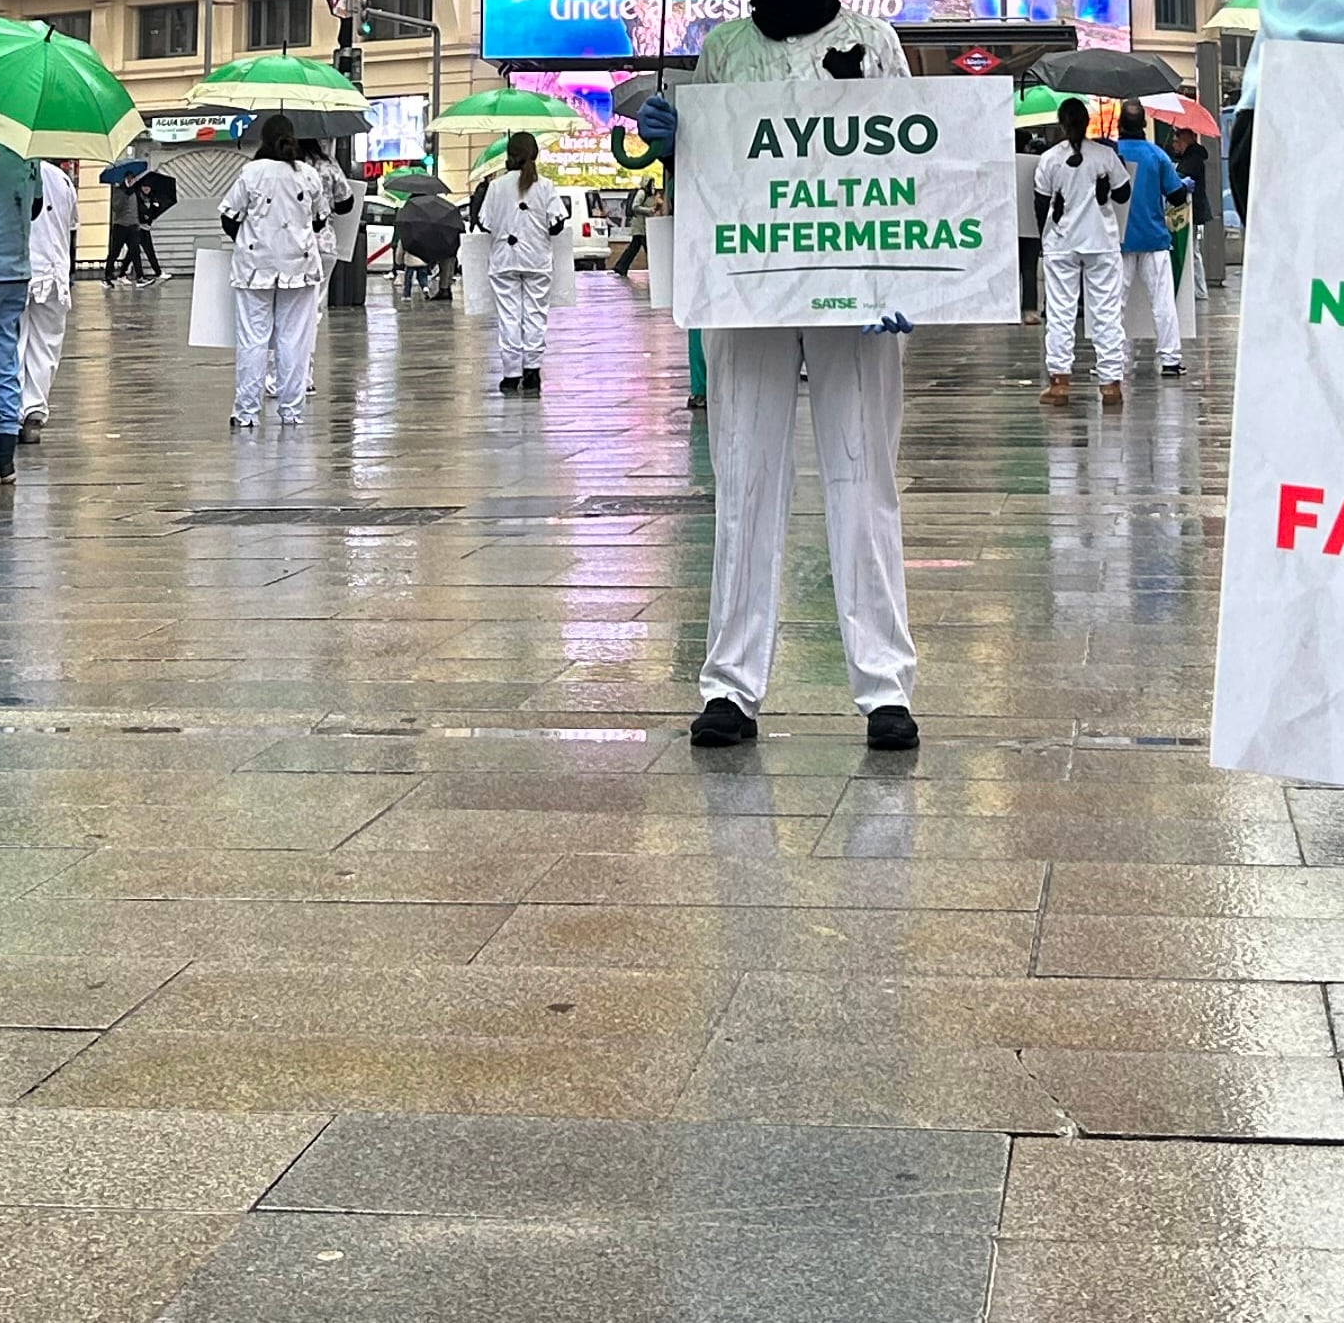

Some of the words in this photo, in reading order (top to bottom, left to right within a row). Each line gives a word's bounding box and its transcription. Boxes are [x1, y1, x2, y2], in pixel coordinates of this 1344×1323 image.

[747, 113, 939, 160] AYUSO
[769, 177, 916, 209] FALTAN
[714, 218, 983, 255] ENFERMERAS
[811, 297, 858, 310] SATSE
